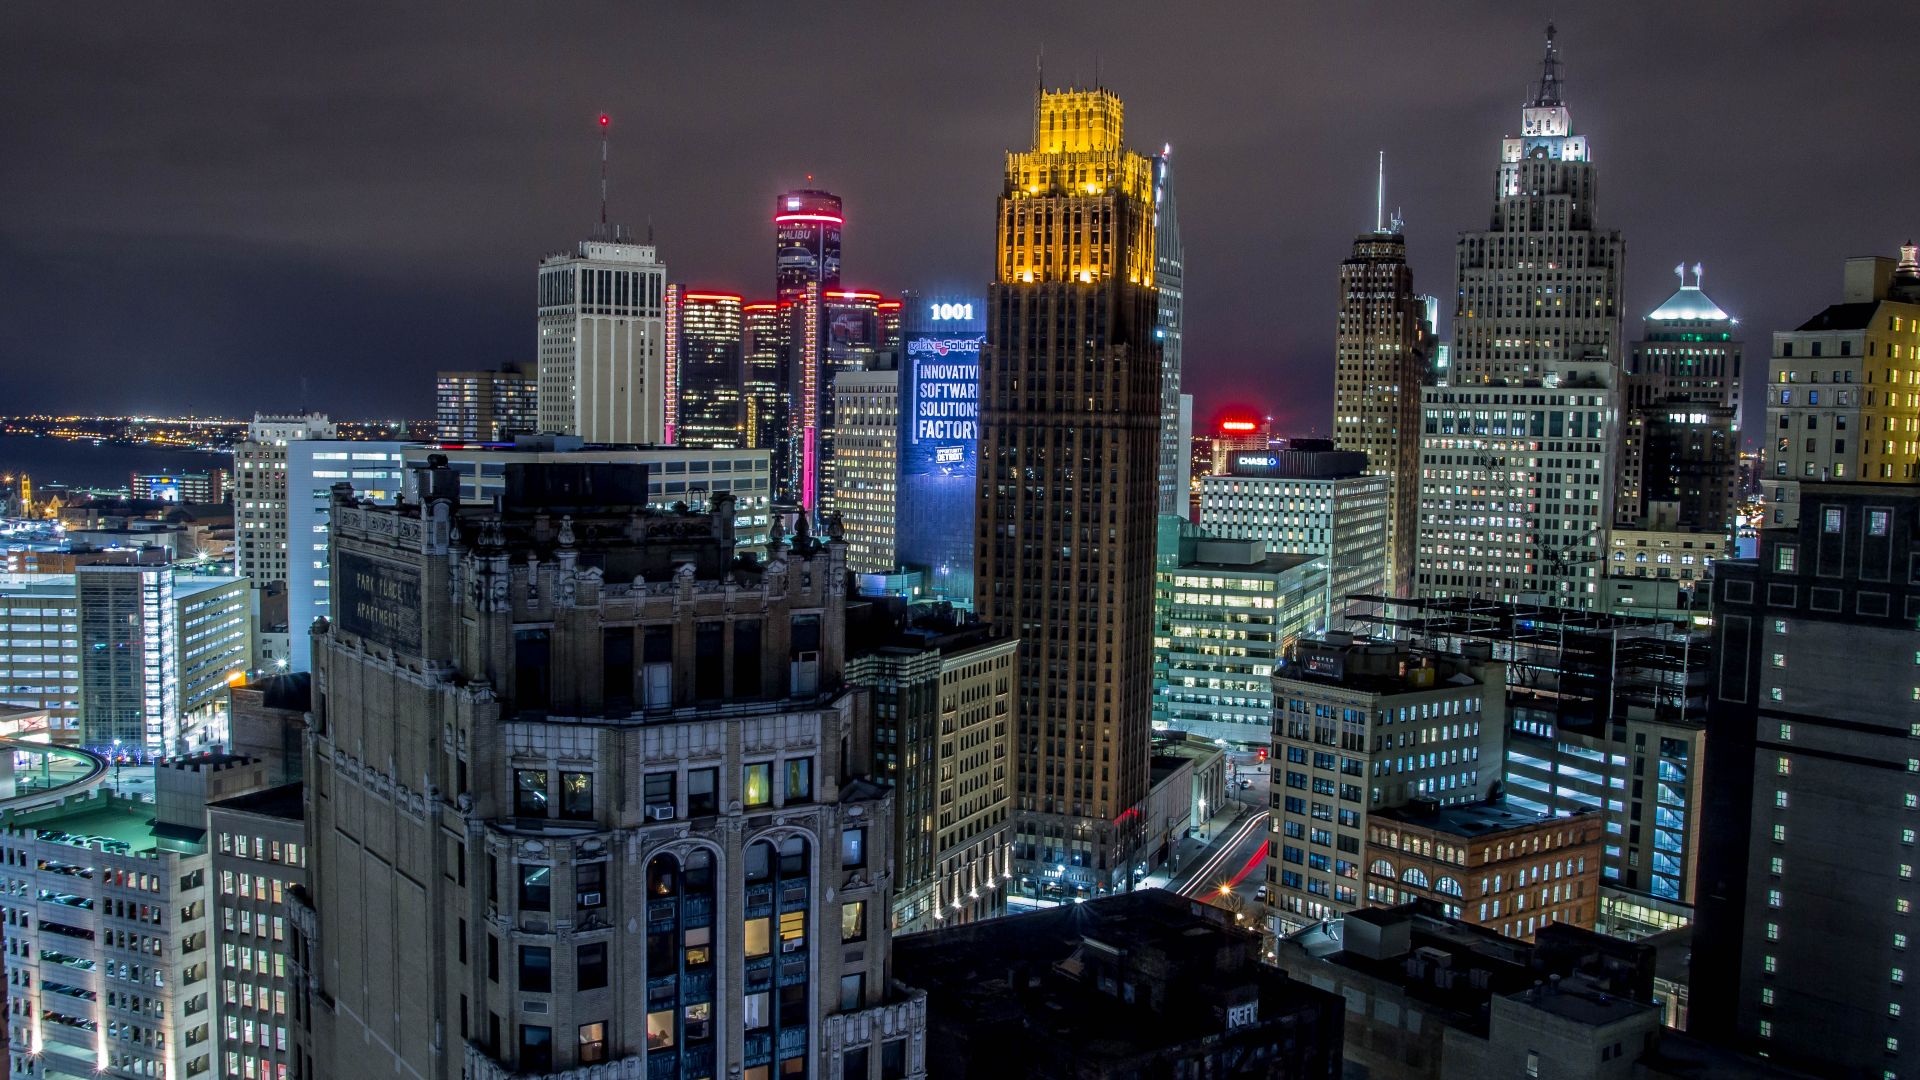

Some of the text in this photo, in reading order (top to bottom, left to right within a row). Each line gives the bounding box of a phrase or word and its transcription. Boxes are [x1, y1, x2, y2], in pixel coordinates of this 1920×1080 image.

[931, 303, 975, 320] 1001
[919, 420, 978, 439] FACTORY
[1239, 457, 1268, 465] CHASE
